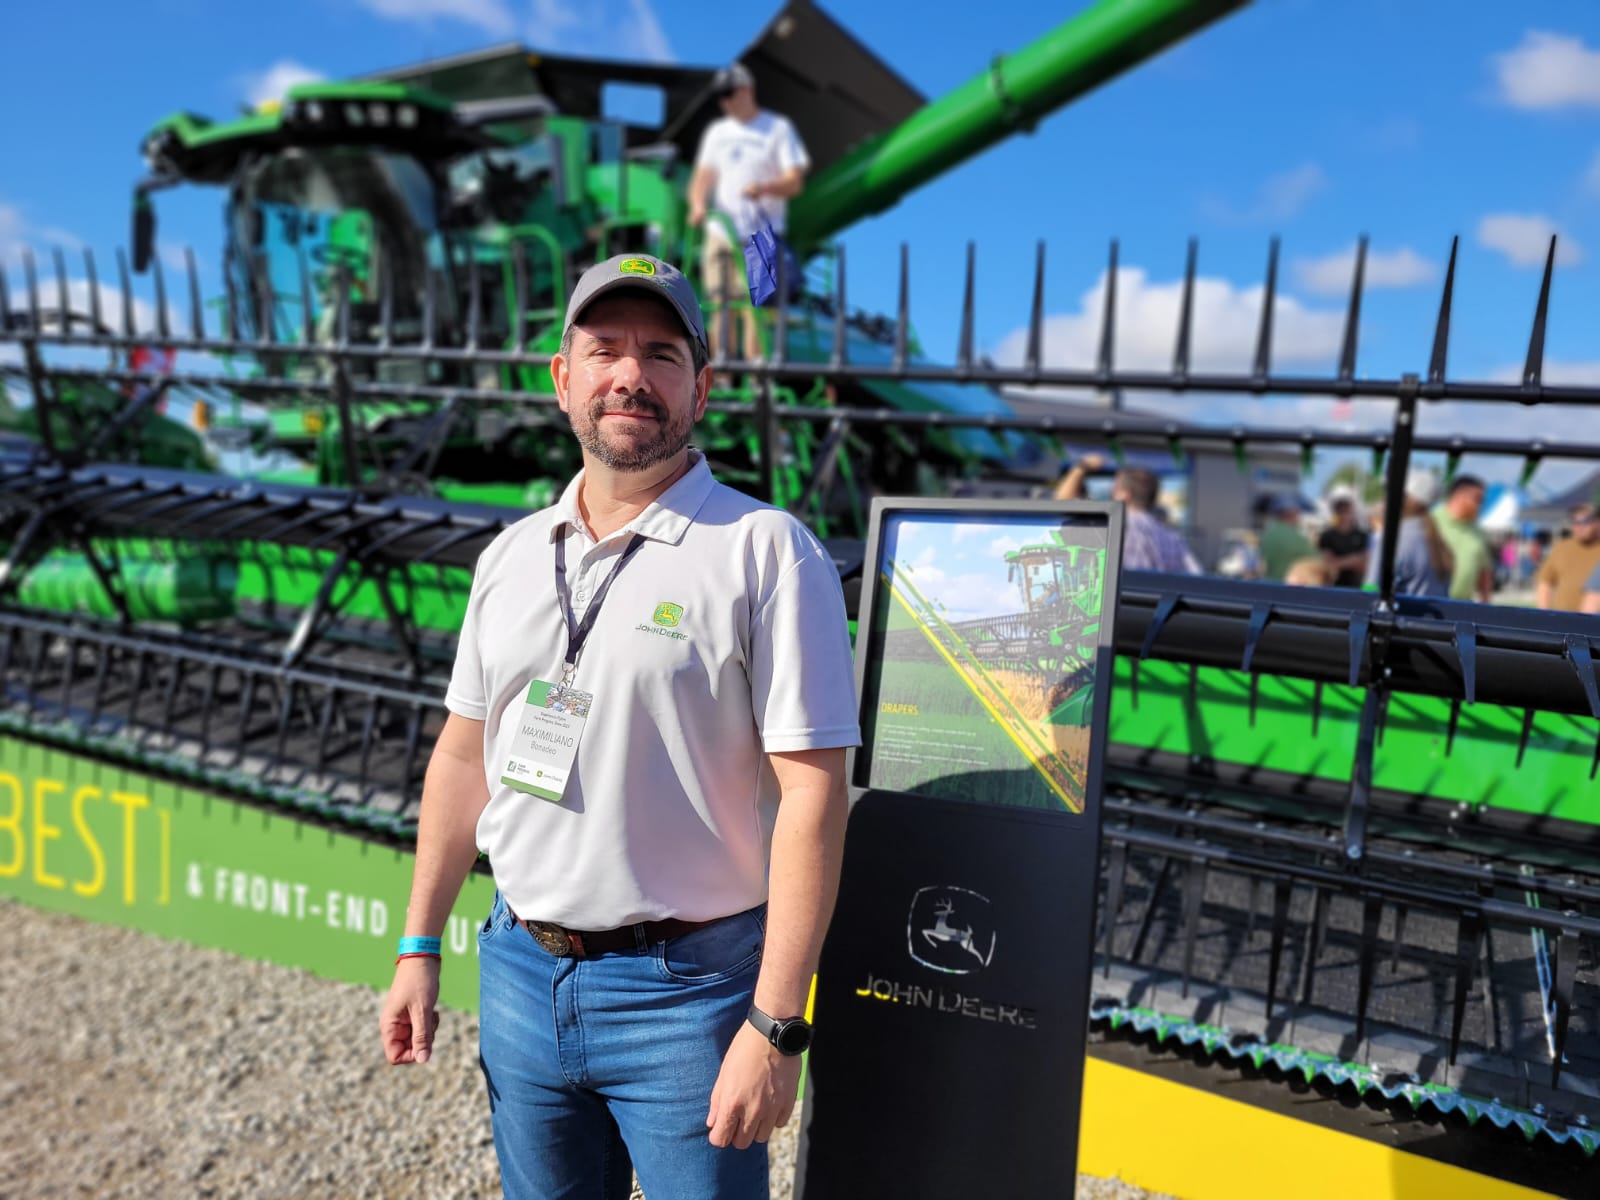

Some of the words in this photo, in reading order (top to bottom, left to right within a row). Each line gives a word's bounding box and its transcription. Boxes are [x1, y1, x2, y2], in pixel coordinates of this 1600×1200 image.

[635, 623, 659, 634] JOHN
[659, 628, 689, 641] DEERE
[881, 702, 919, 716] DRAPERS
[521, 725, 574, 748] MAXIMILIANO
[187, 863, 204, 898] &
[215, 868, 389, 937] FRONT-END
[856, 973, 934, 1008] JOHN
[938, 988, 1037, 1029] DEERE
